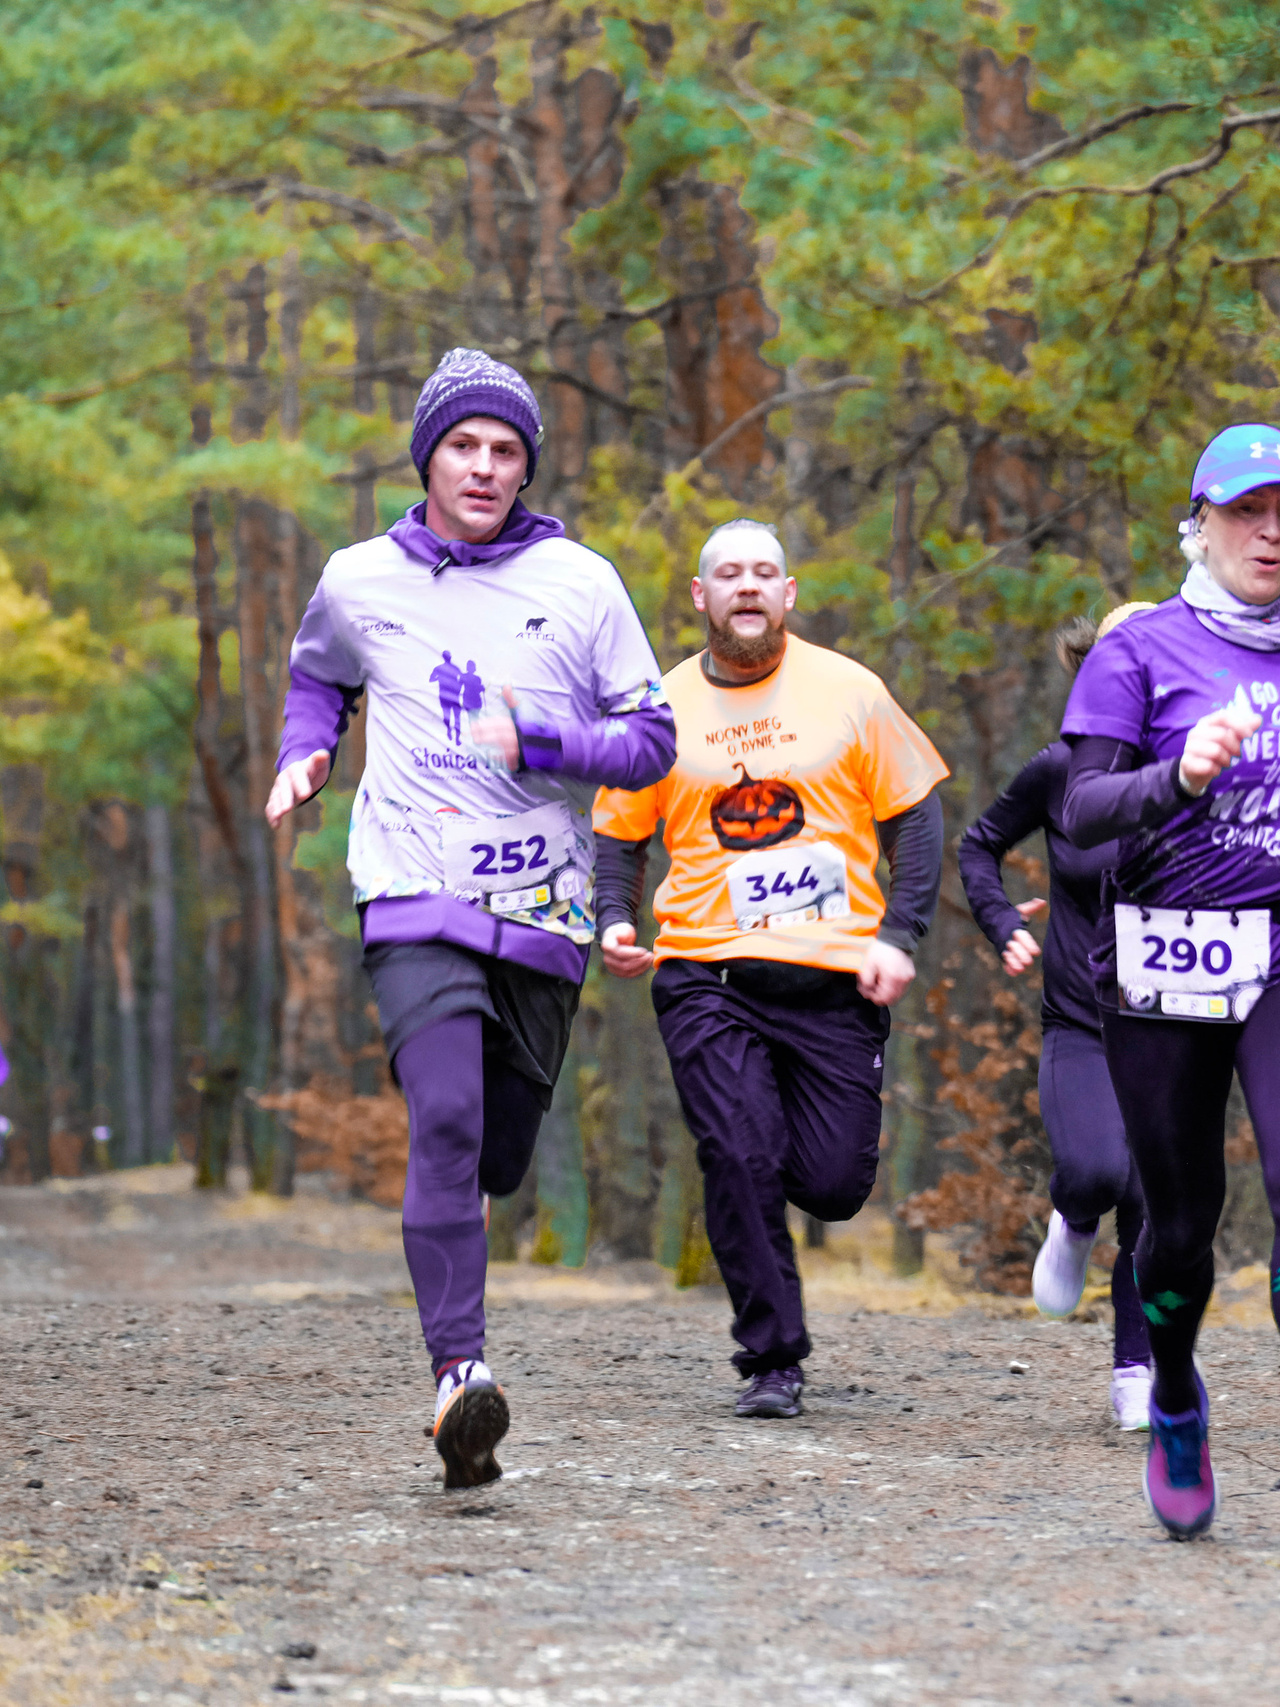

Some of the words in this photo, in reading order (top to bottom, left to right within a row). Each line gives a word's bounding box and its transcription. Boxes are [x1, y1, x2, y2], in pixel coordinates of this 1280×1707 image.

[1250, 681, 1279, 712] GO
[705, 723, 749, 746] NOCNY
[753, 716, 782, 735] BIEG
[727, 743, 737, 756] O
[470, 834, 549, 876] 252
[746, 865, 820, 902] 344
[1141, 934, 1232, 976] 290
